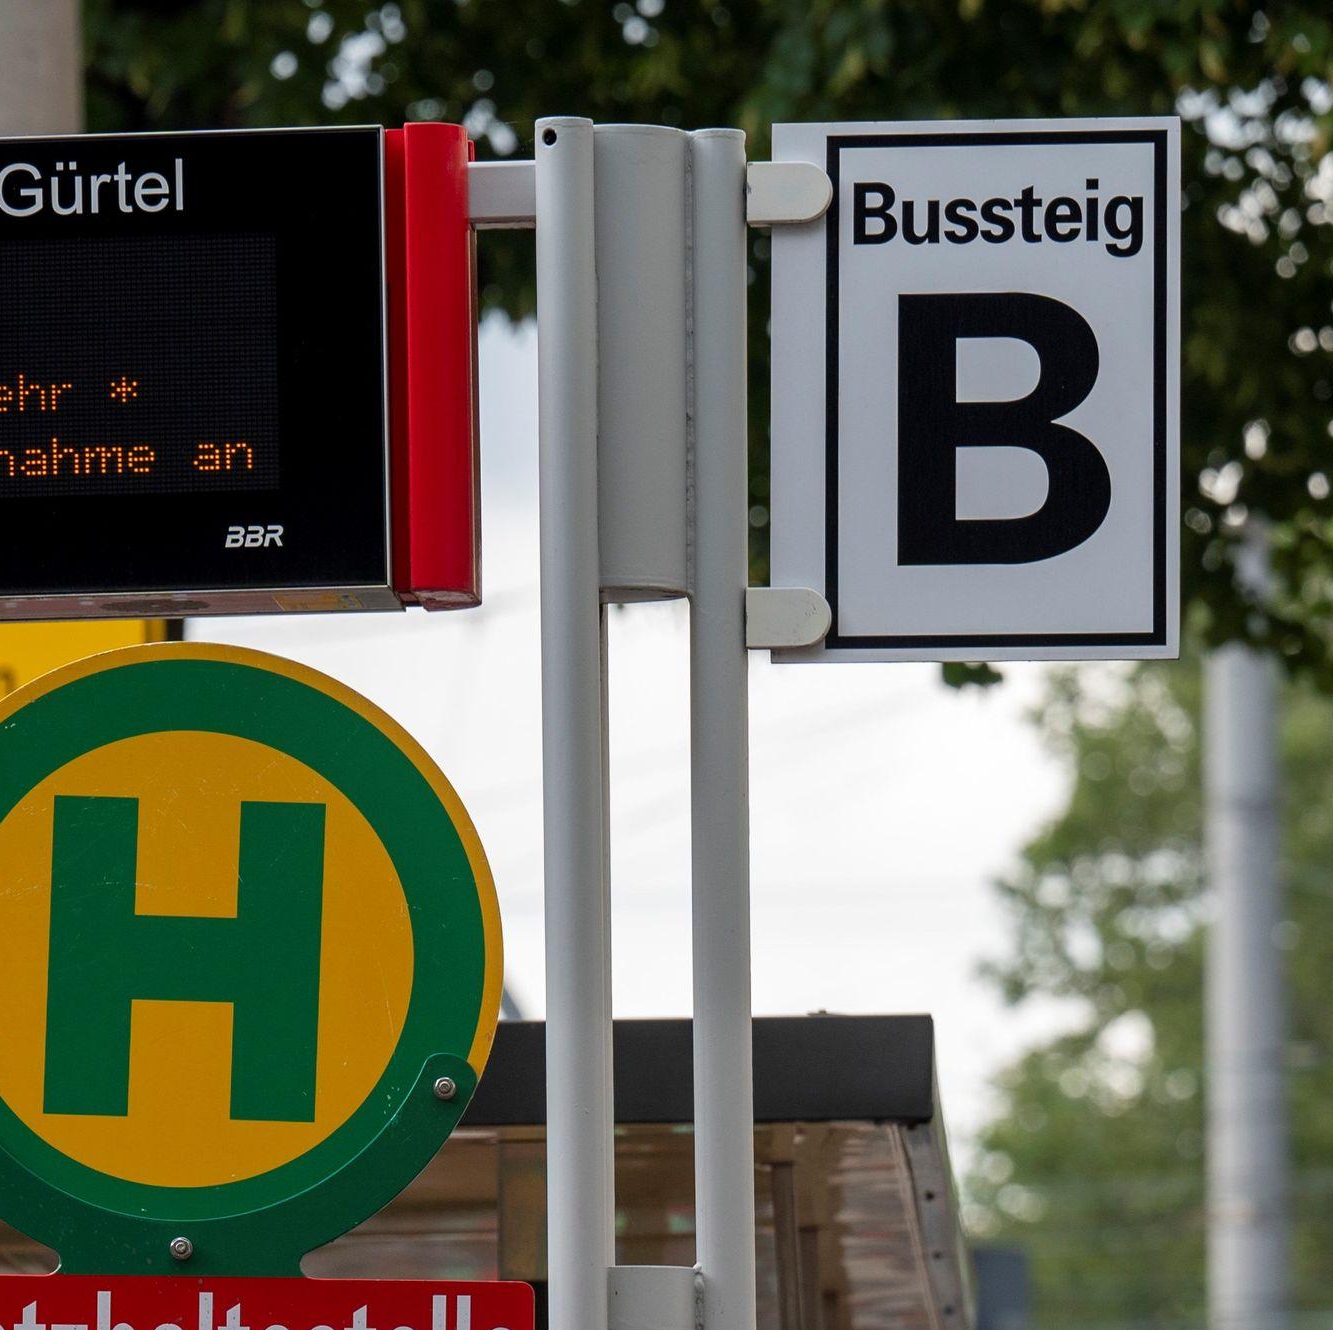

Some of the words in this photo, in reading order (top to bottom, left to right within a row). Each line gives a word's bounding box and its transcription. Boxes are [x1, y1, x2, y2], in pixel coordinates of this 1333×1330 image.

[852, 177, 1144, 258] Bussteig
[194, 442, 253, 472] an
[898, 291, 1112, 566] B
[224, 524, 284, 548] BBR
[42, 794, 327, 1123] H
